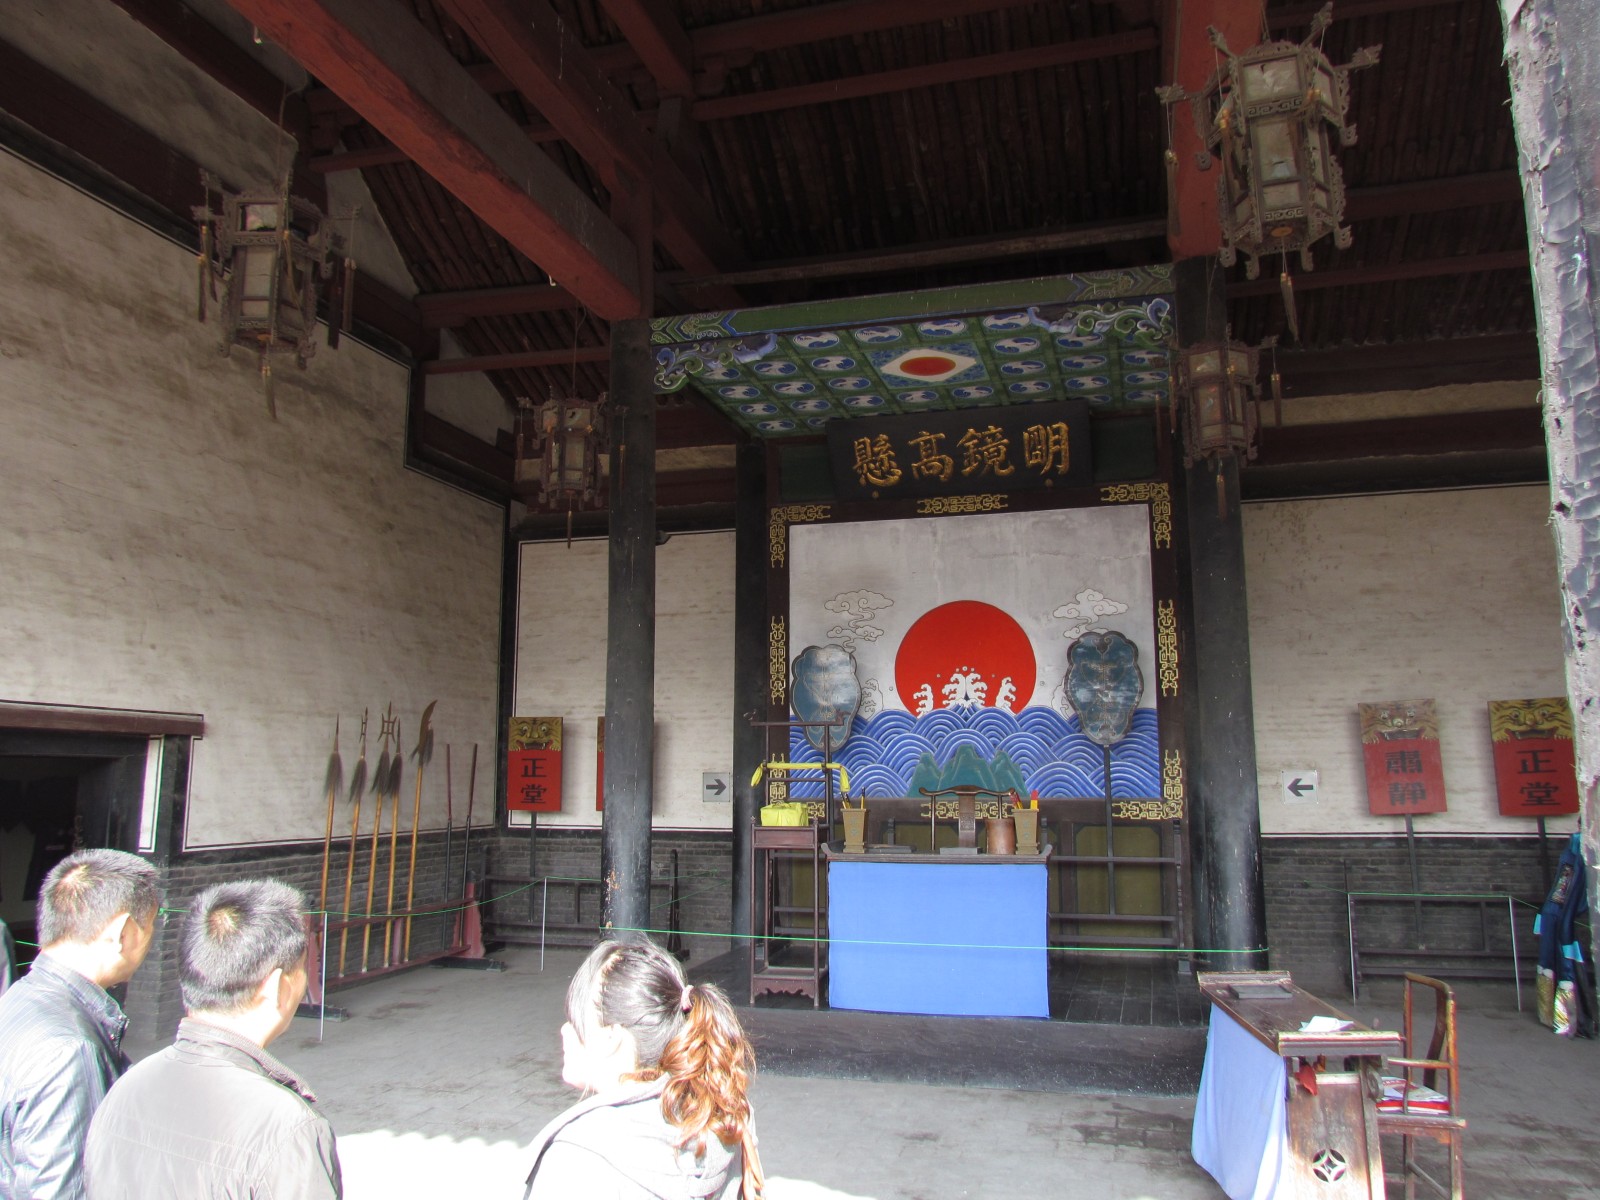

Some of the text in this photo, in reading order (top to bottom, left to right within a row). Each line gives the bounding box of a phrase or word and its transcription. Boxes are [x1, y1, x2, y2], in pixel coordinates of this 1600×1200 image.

[520, 757, 547, 804] 正堂
[1385, 750, 1427, 806] 肅靜
[1516, 749, 1561, 806] 正堂
